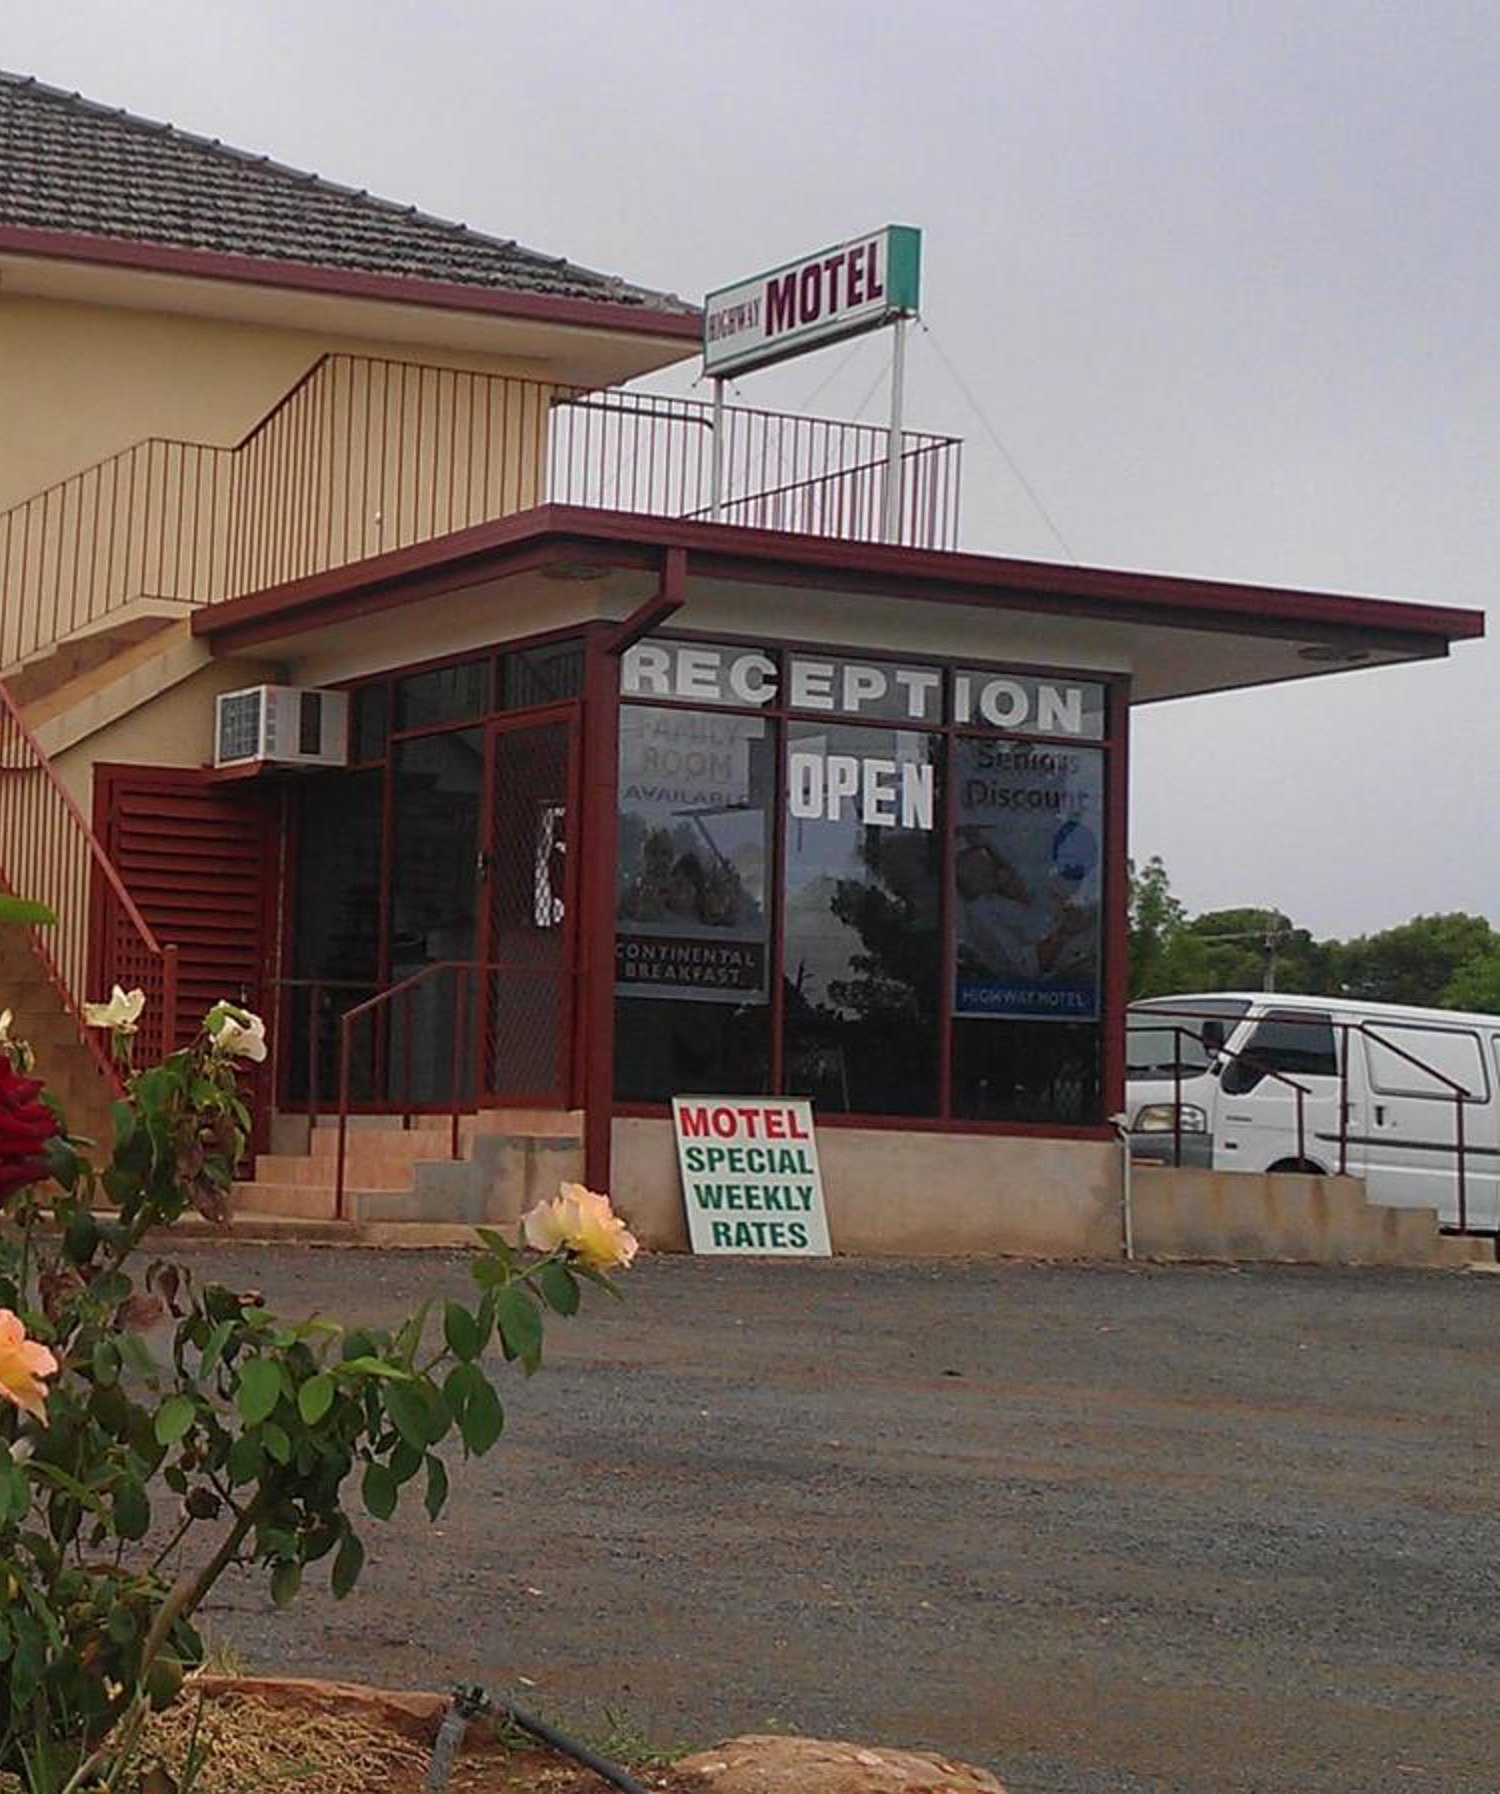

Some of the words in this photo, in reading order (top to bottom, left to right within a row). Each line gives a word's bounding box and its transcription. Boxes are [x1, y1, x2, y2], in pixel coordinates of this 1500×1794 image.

[707, 297, 761, 342] HIGHWAY
[765, 241, 883, 336] MOTEL
[622, 646, 1082, 733] RECEPTION
[643, 747, 733, 780] ROOM
[789, 753, 934, 830] OPEN
[615, 942, 756, 967] CONTINENTAL
[625, 962, 741, 983] BREAKFAST
[679, 1106, 809, 1139] MOTEL
[685, 1147, 814, 1174] SPECIAL
[694, 1184, 813, 1211] WEEKLY
[712, 1220, 809, 1248] RATES
